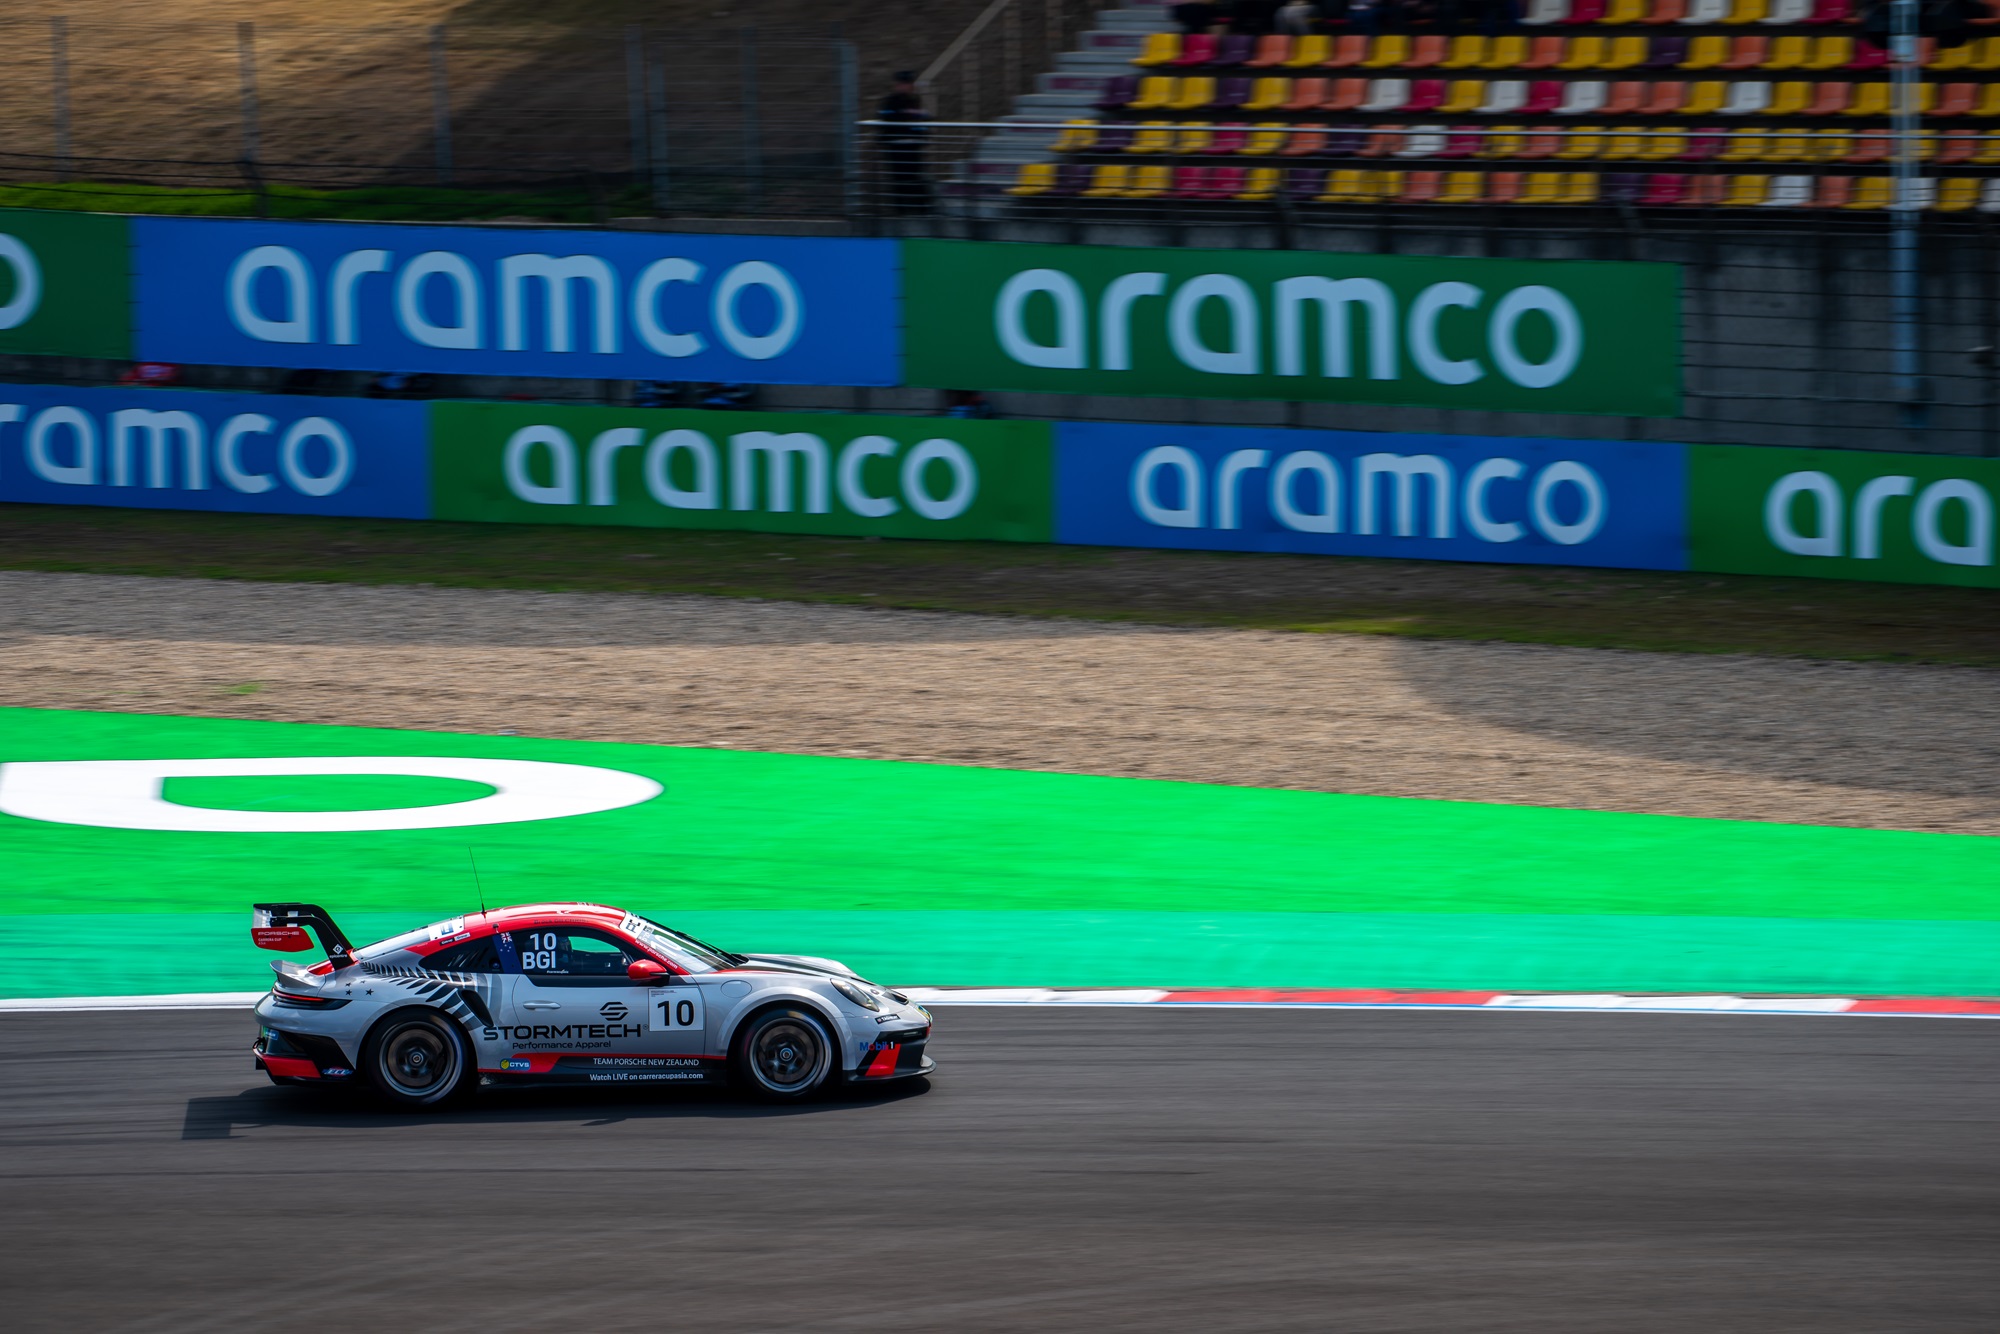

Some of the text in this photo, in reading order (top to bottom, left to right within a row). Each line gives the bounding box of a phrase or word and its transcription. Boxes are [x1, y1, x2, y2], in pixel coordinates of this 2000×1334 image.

[231, 245, 801, 361] aramco
[996, 267, 1582, 389] aramco
[506, 424, 977, 521] aramco
[1133, 444, 1605, 546] aramco
[529, 932, 557, 951] 10
[522, 951, 556, 970] BGI
[635, 940, 678, 970] www.porsche.com
[657, 999, 695, 1027] 10
[483, 1024, 641, 1041] STORMTECH
[512, 1040, 612, 1050] Performance Apparel
[859, 1041, 888, 1051] Mobil
[593, 1057, 613, 1065] TEAM
[614, 1058, 647, 1066] PORSCHE
[648, 1058, 665, 1066] NEW
[589, 1073, 612, 1081] Watch
[638, 1072, 704, 1081] carreracupasia.com
